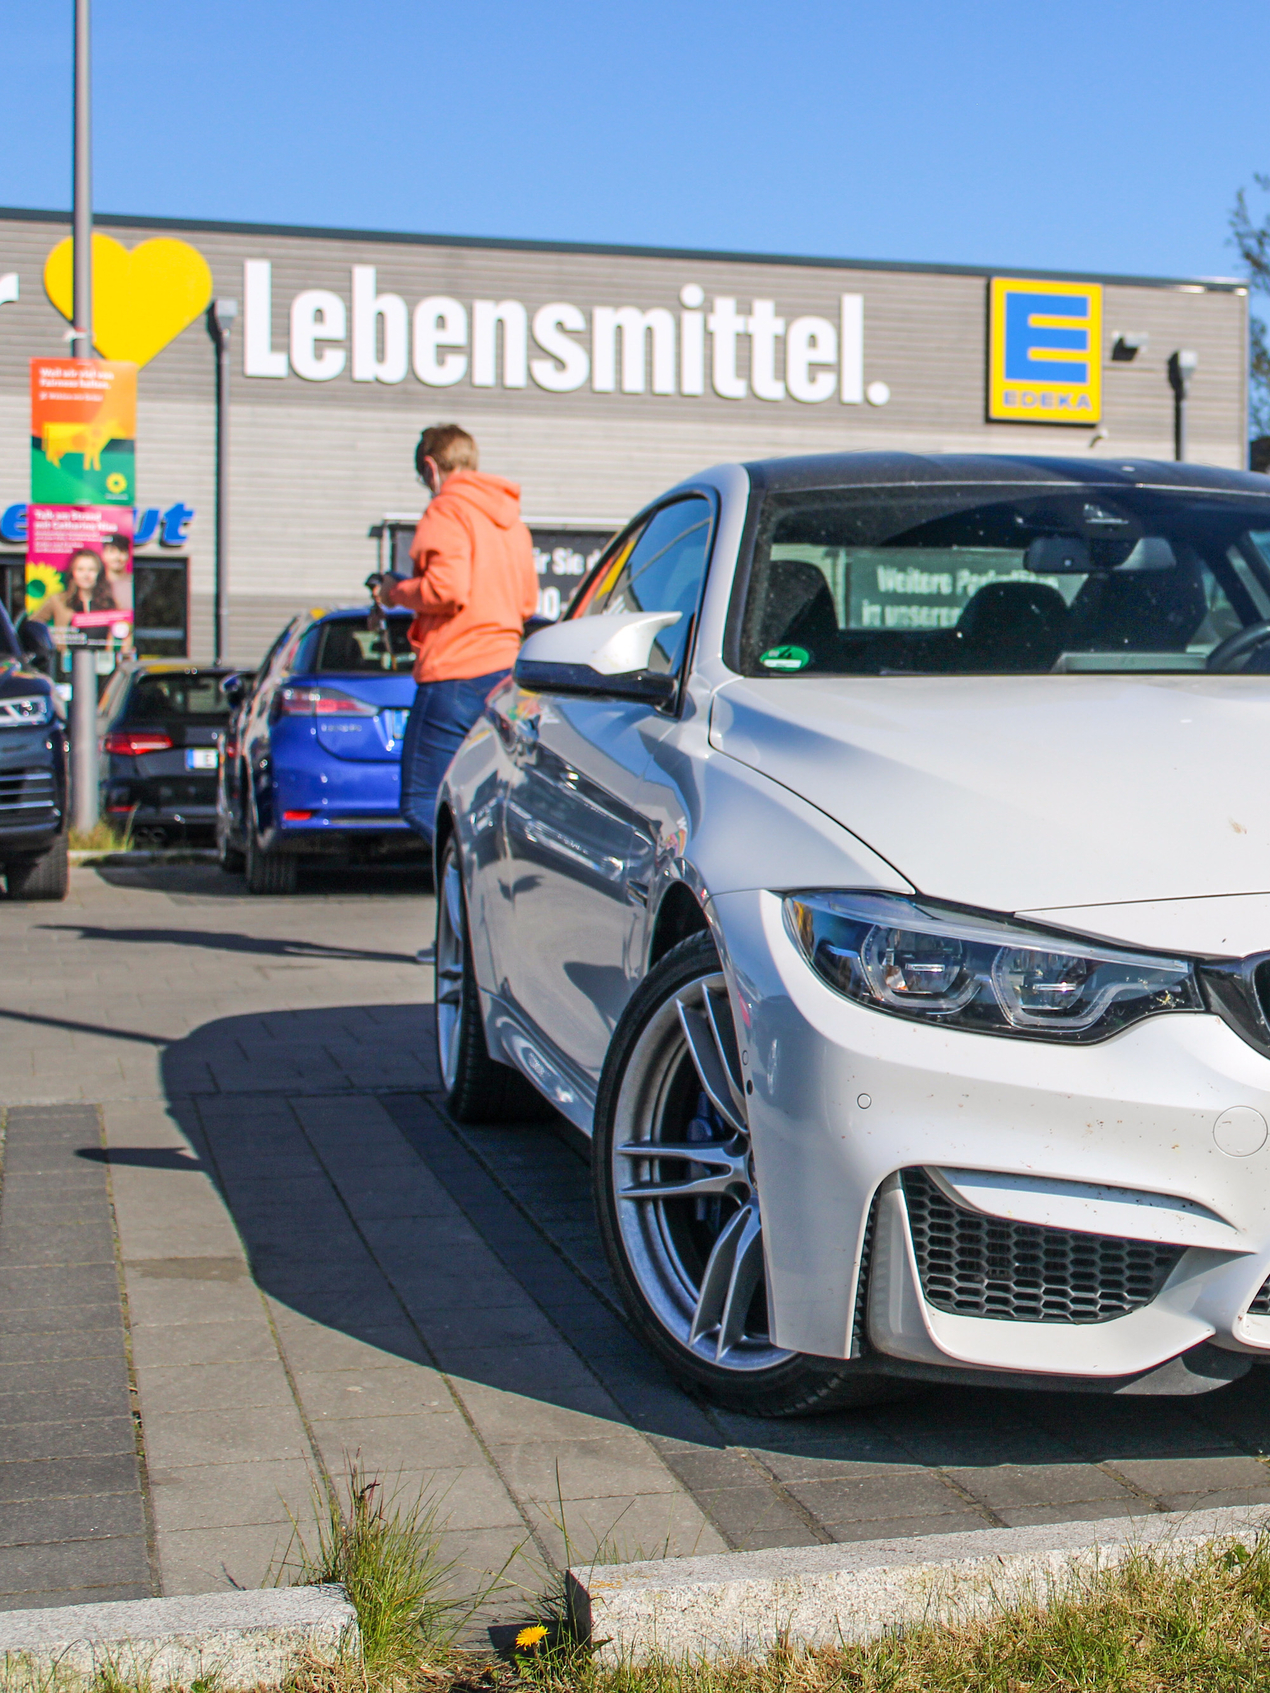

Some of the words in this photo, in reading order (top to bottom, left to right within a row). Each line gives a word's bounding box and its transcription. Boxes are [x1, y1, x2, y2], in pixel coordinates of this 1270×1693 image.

[243, 258, 890, 408] Lebensmittel.
[1003, 391, 1092, 411] EDEKA
[552, 547, 585, 575] Sie
[877, 565, 952, 595] Weitere
